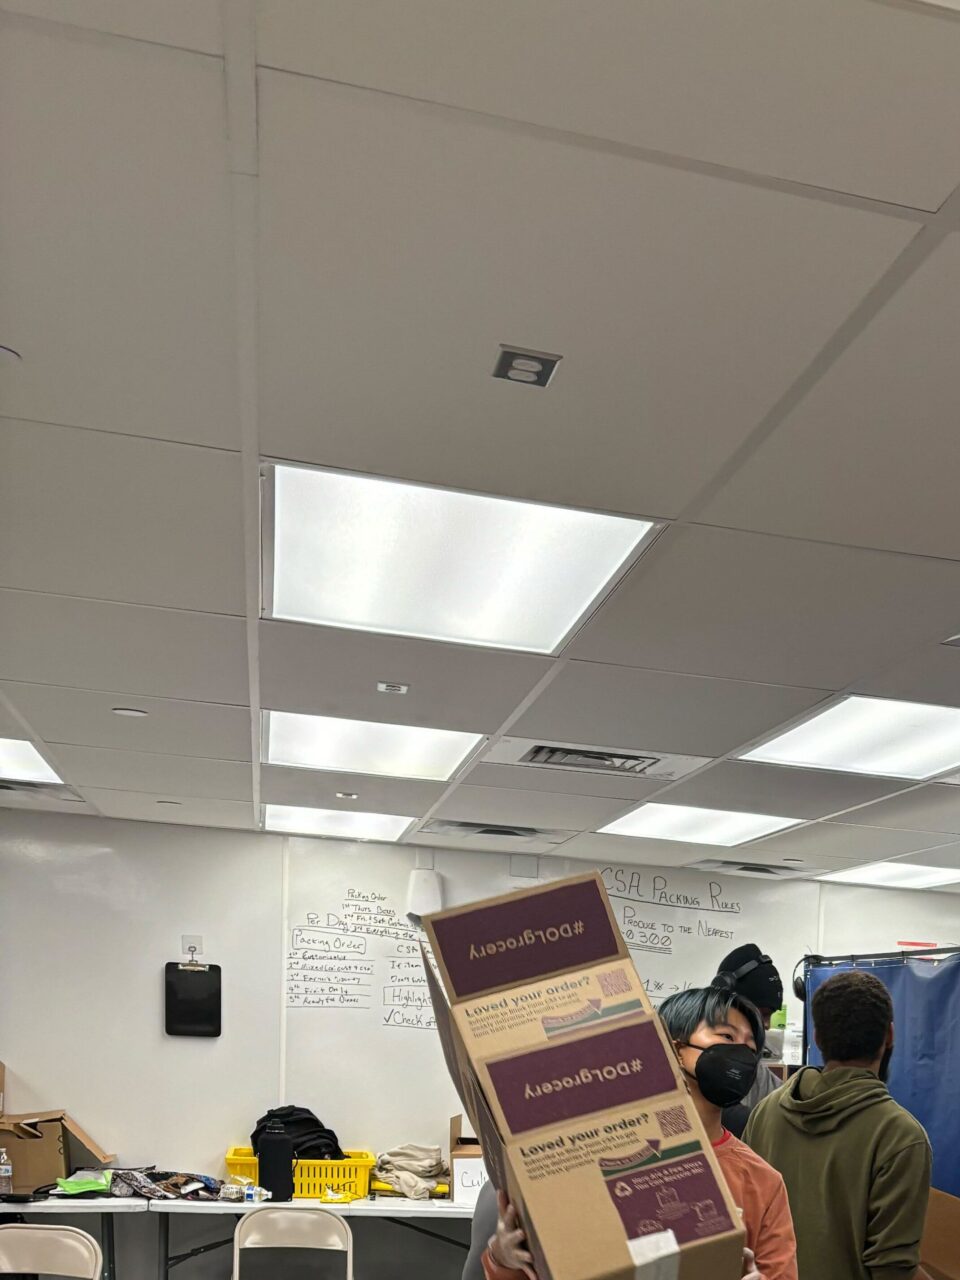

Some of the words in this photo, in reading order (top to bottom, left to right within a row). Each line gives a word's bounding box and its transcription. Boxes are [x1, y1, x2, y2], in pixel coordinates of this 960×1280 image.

[601, 867, 644, 897] CSA
[307, 912, 321, 925] Per
[296, 929, 330, 952] Packing
[333, 937, 364, 949] Order
[397, 944, 418, 954] CSA
[469, 920, 585, 960] #DOLgrocery
[464, 998, 508, 1018] Loved
[511, 990, 543, 1007] your
[546, 975, 590, 995] order?
[393, 1010, 423, 1026] Check
[524, 1058, 643, 1100] #DOLgrocery
[520, 1135, 565, 1157] Loved
[567, 1128, 599, 1146] your
[602, 1112, 649, 1133] order?
